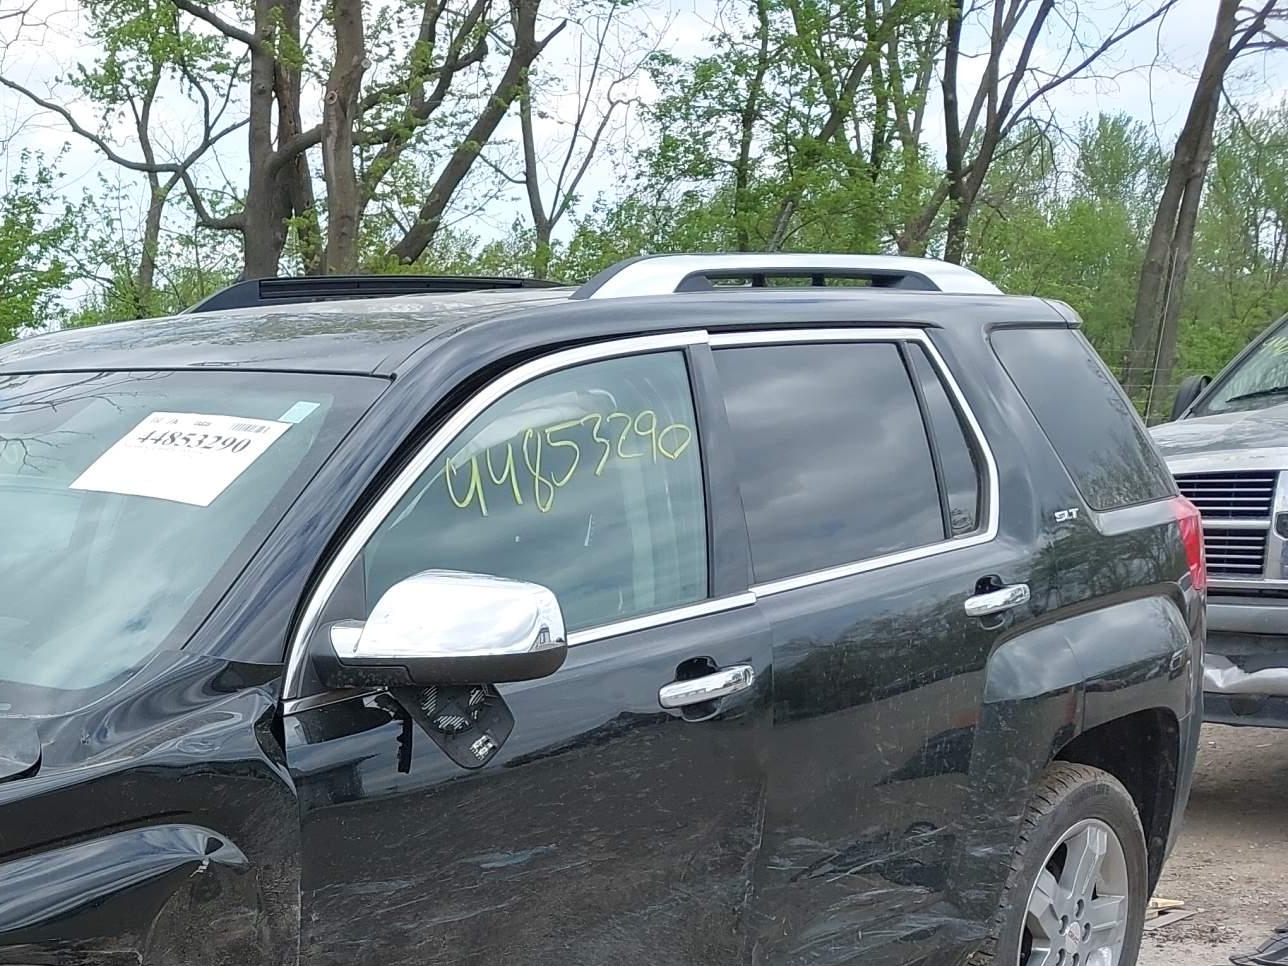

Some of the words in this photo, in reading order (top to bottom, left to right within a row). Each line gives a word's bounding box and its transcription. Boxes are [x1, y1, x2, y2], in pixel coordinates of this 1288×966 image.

[137, 429, 252, 454] 44853290
[446, 410, 692, 517] 44853290
[1054, 507, 1079, 523] SLT
